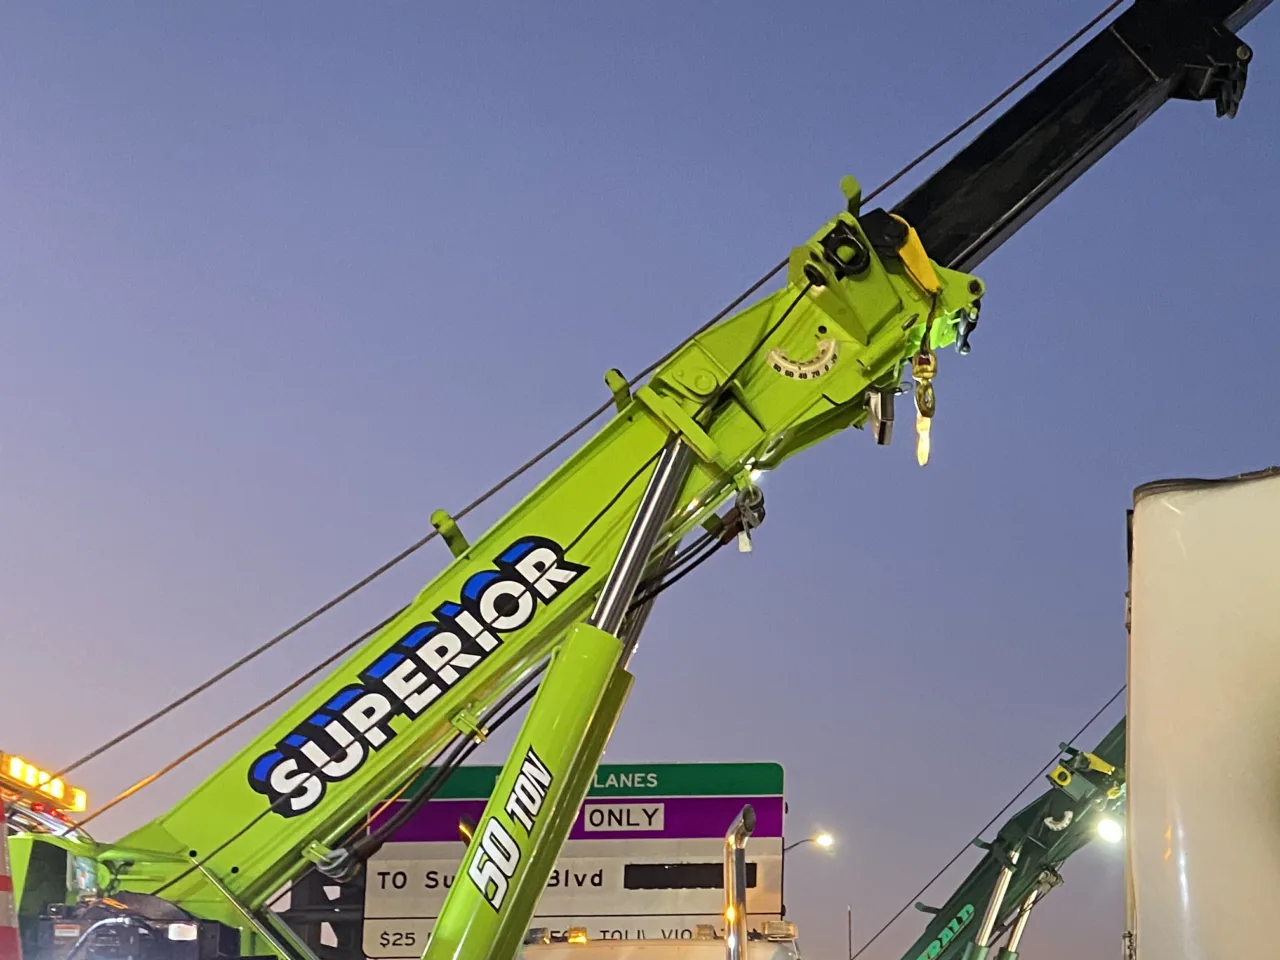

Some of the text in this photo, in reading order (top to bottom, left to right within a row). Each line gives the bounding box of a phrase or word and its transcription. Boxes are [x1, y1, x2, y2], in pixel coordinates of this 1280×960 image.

[260, 540, 584, 814] SUPERIOR
[593, 773, 659, 789] LANES
[588, 808, 660, 828] ONLY
[467, 745, 554, 913] 50 TON
[377, 871, 408, 890] TO
[546, 868, 604, 888] Blvd
[379, 930, 417, 948] $25
